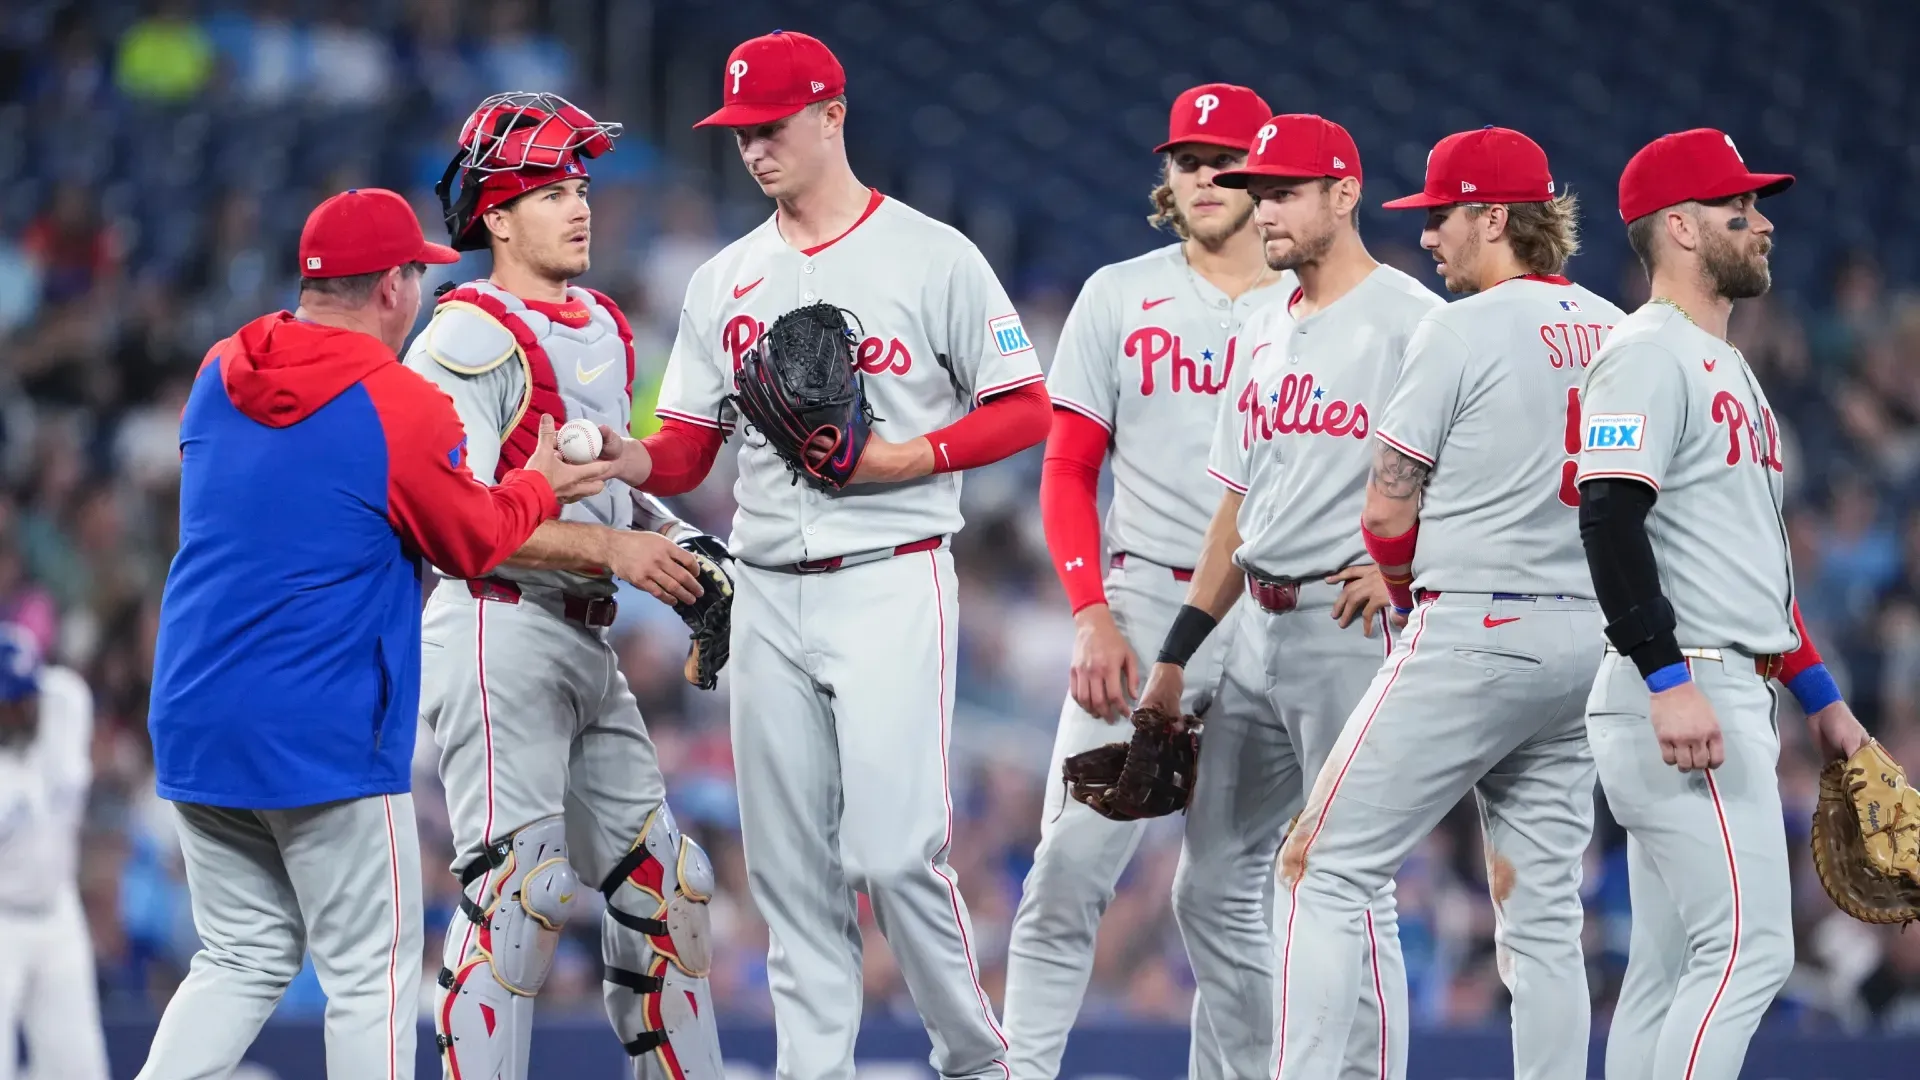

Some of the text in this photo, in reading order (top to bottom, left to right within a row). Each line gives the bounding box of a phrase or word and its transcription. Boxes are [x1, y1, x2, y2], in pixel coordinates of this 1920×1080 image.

[729, 59, 749, 95] P
[1195, 94, 1220, 125] P
[1256, 123, 1278, 155] P
[996, 325, 1030, 352] IBX
[1539, 323, 1615, 369] STOT
[1587, 425, 1639, 448] IBX
